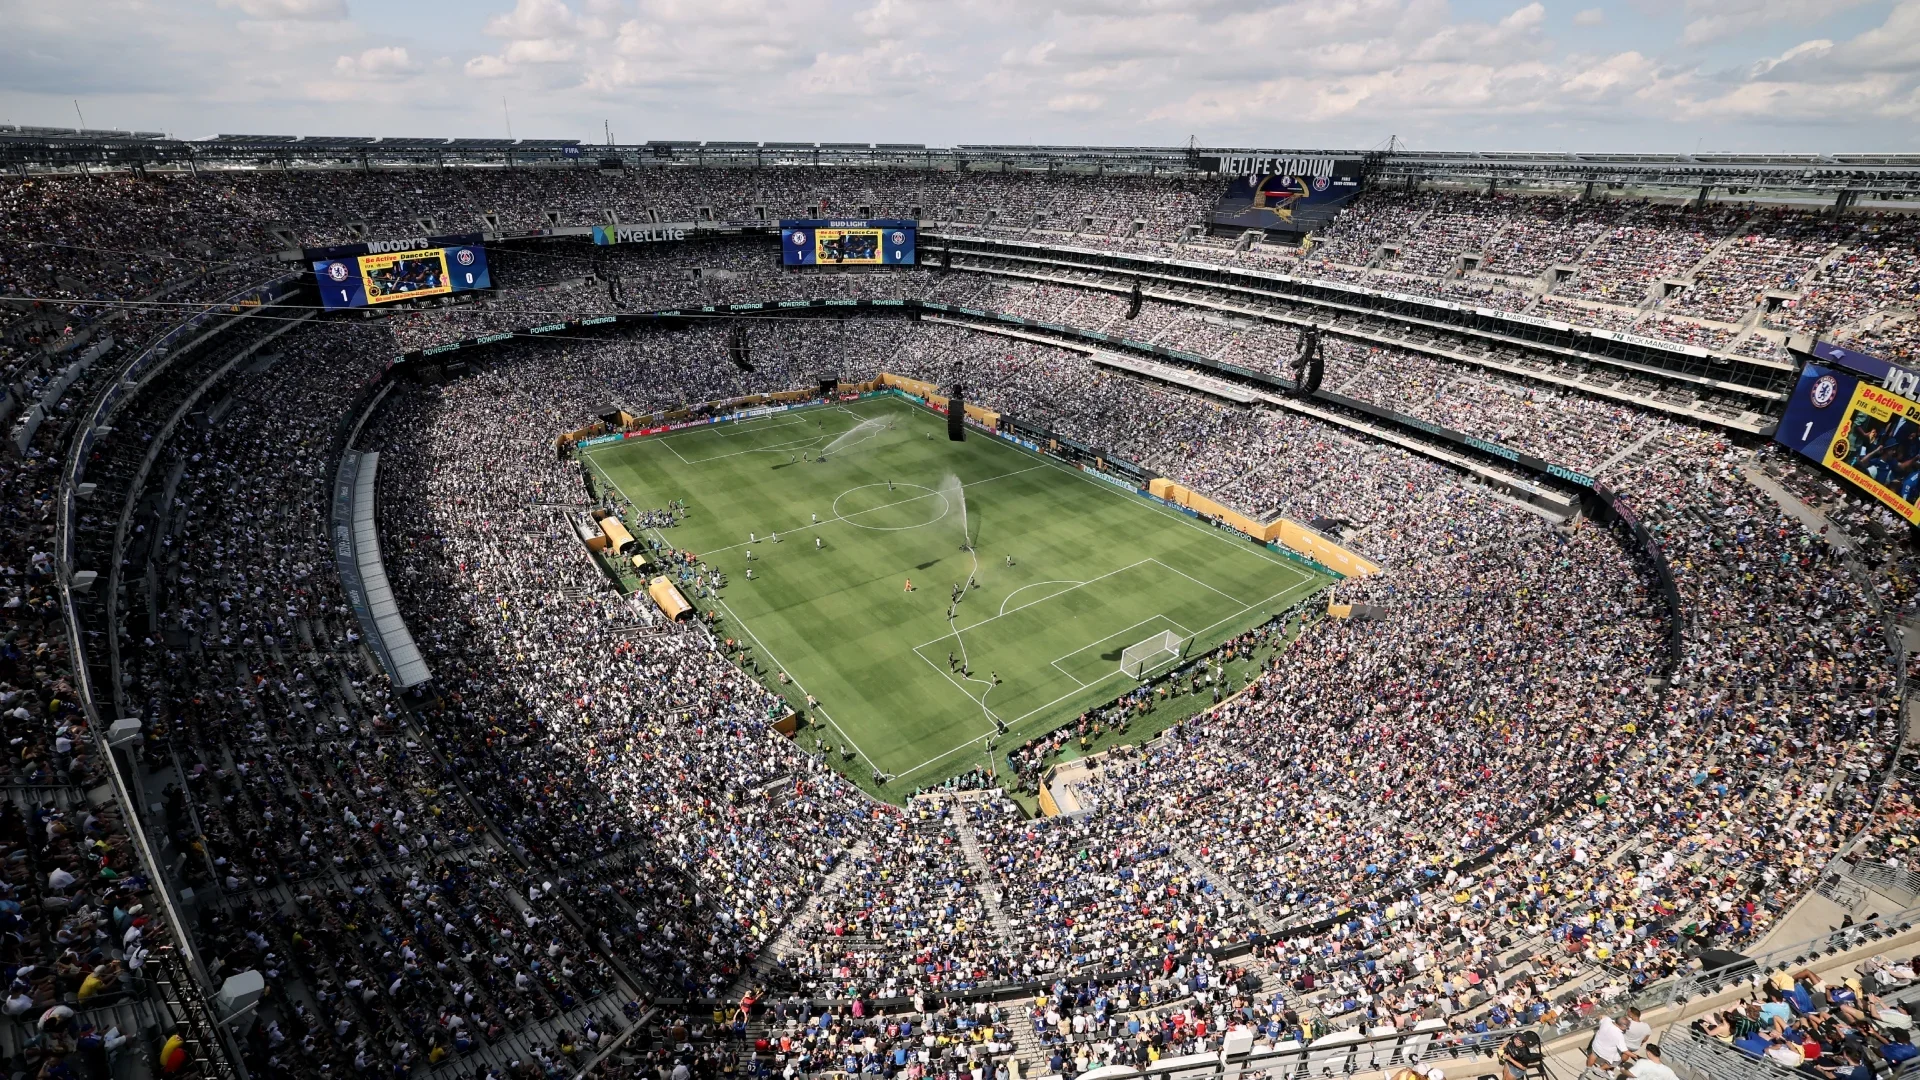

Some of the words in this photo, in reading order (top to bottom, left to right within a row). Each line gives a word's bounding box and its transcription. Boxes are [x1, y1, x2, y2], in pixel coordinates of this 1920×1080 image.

[1219, 156, 1271, 175] METLIFE
[1274, 159, 1335, 177] STADIUM
[617, 226, 685, 243] MetLife
[367, 237, 429, 254] MOODY'S
[375, 254, 397, 262] Active
[400, 252, 423, 260] Dance
[424, 250, 440, 258] Cam
[797, 250, 802, 260] 1
[895, 250, 901, 260] 0
[465, 272, 474, 284] 0
[340, 289, 348, 302] 1
[582, 315, 617, 326] POWERADE
[1493, 310, 1504, 319] 93
[1506, 313, 1529, 324] MARTY
[1530, 317, 1551, 328] LYONS
[530, 323, 566, 334] POWERADE
[477, 331, 514, 344] POWERADE
[1611, 332, 1625, 341] 74
[1626, 336, 1644, 345] NICK
[1644, 339, 1685, 352] MANGOLD
[423, 342, 460, 356] POWERADE
[1168, 349, 1202, 363] POWERADE
[1217, 362, 1253, 377] POWERADE
[1882, 366, 1920, 403] HCL
[1856, 399, 1868, 409] FIFA
[1863, 388, 1876, 400] Be
[1875, 393, 1904, 412] Active
[1393, 412, 1441, 435] POWERADE
[1801, 421, 1814, 441] 1
[1464, 435, 1520, 462] POWERADE
[1106, 454, 1140, 473] POWERADE
[1859, 478, 1873, 490] active
[1167, 502, 1184, 512] ULTRA
[1220, 523, 1252, 542] motorola
